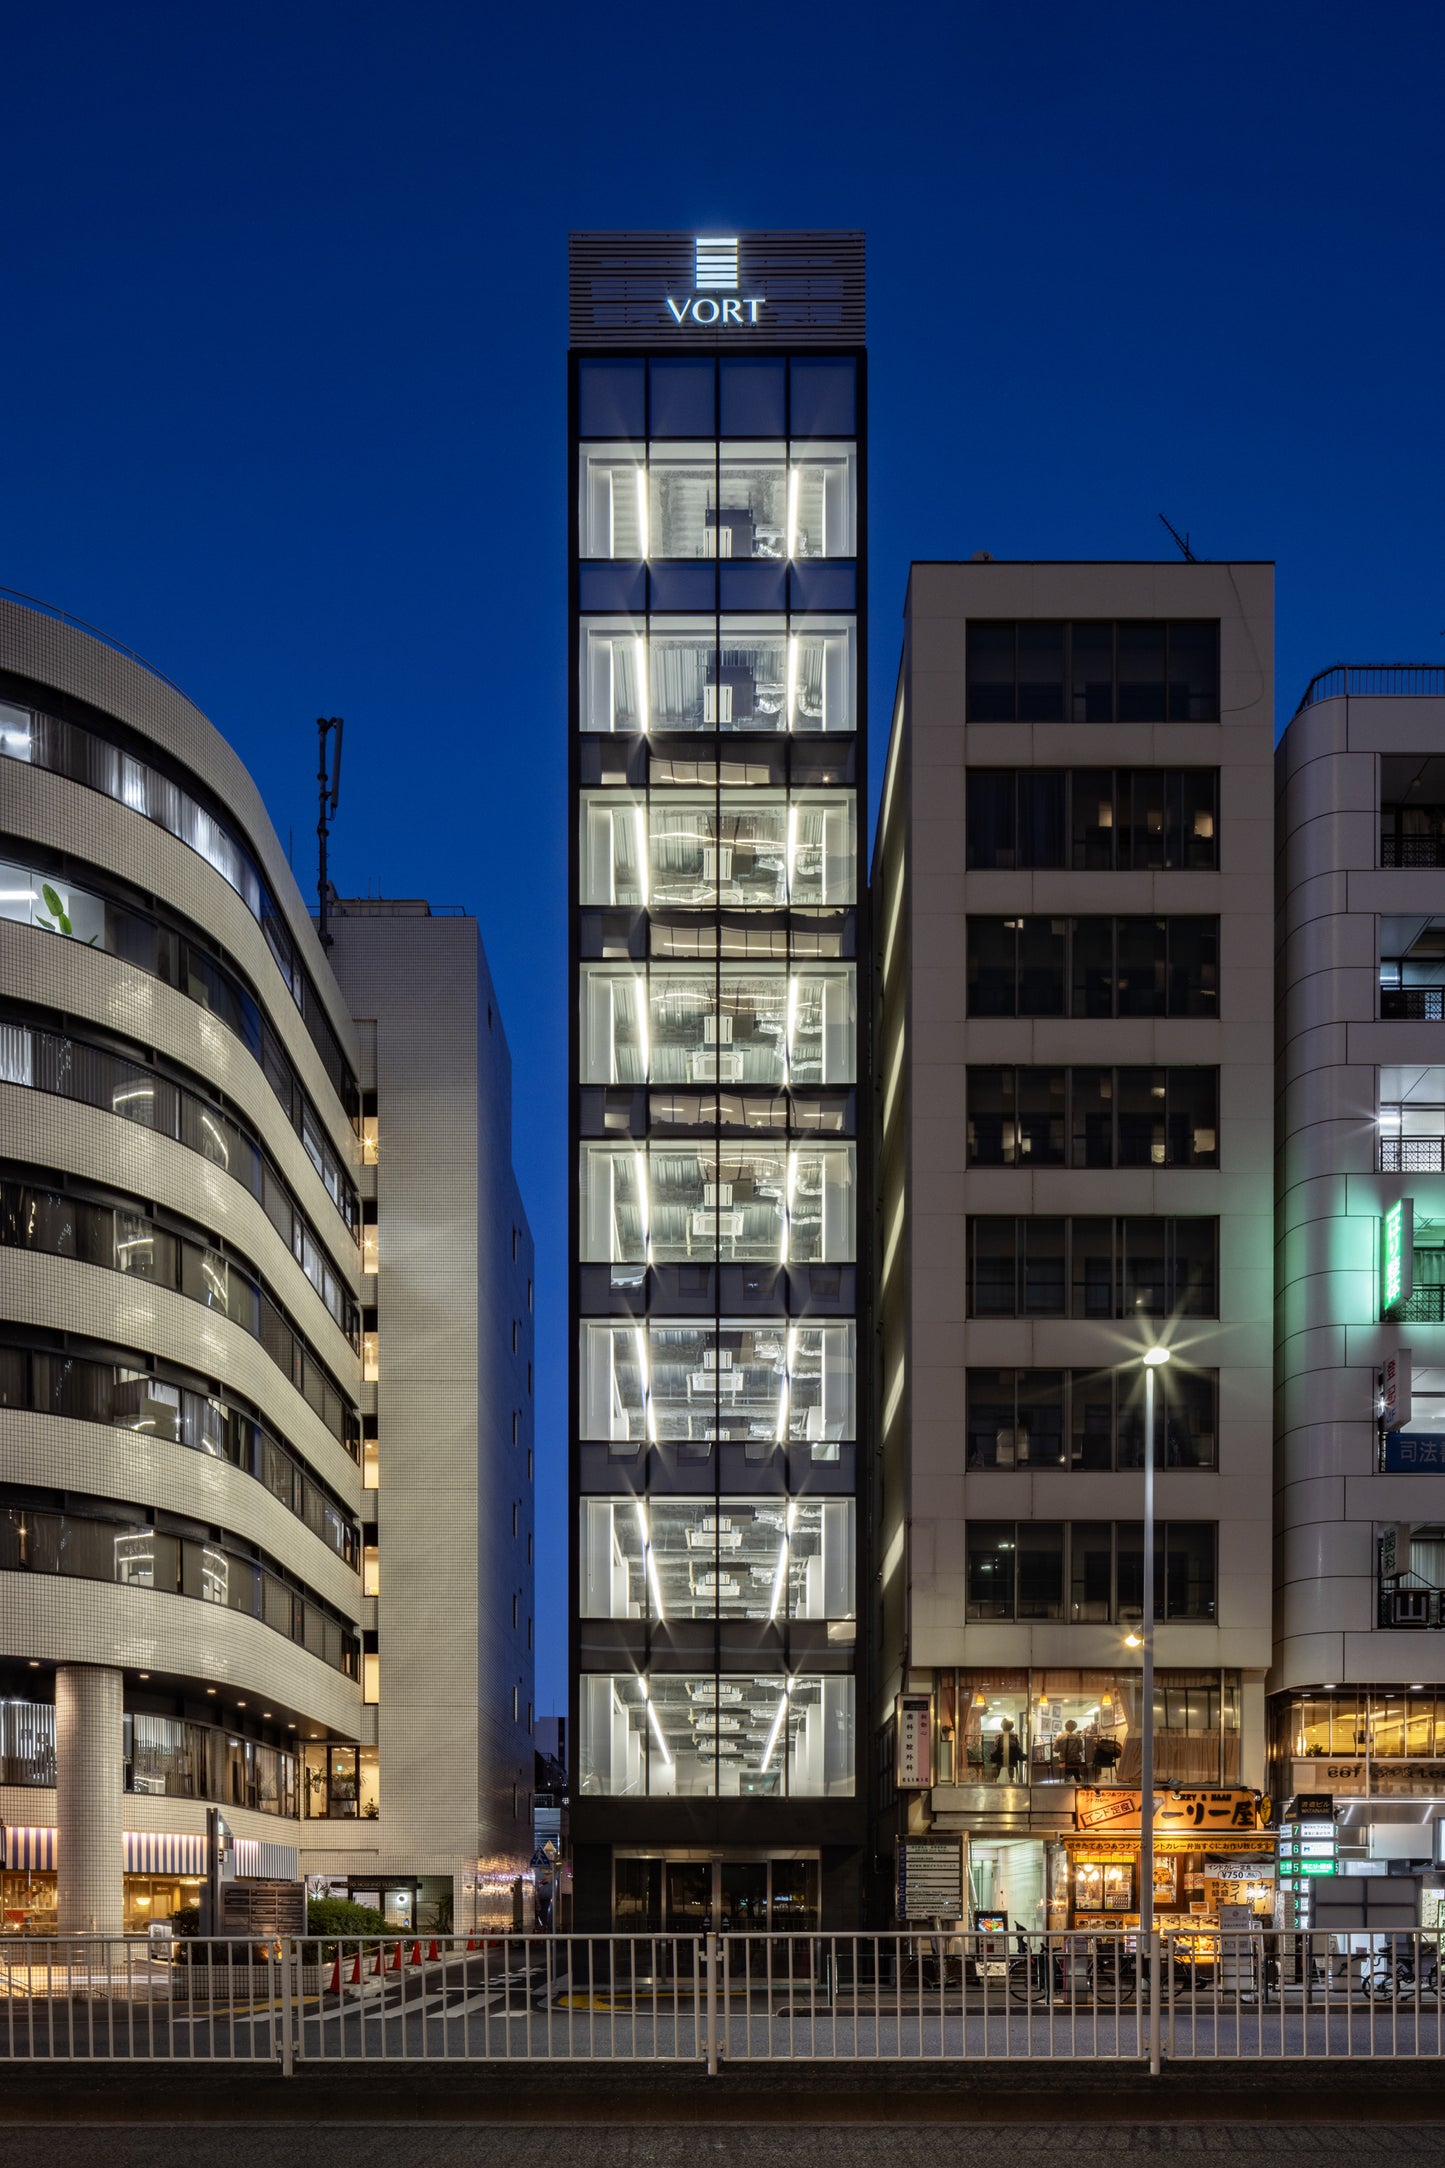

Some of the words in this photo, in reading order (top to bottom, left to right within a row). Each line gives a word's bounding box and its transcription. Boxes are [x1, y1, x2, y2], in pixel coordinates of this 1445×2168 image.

[666, 298, 766, 323] VORT
[1396, 1593, 1445, 1622] 山
[1085, 1802, 1131, 1822] インド定食
[1293, 1825, 1299, 1836] 7
[1293, 1844, 1299, 1854] 6
[1293, 1863, 1299, 1873] 5
[1221, 1871, 1244, 1879] ¥750
[1293, 1881, 1299, 1891] 4
[1294, 1899, 1299, 1910] 3
